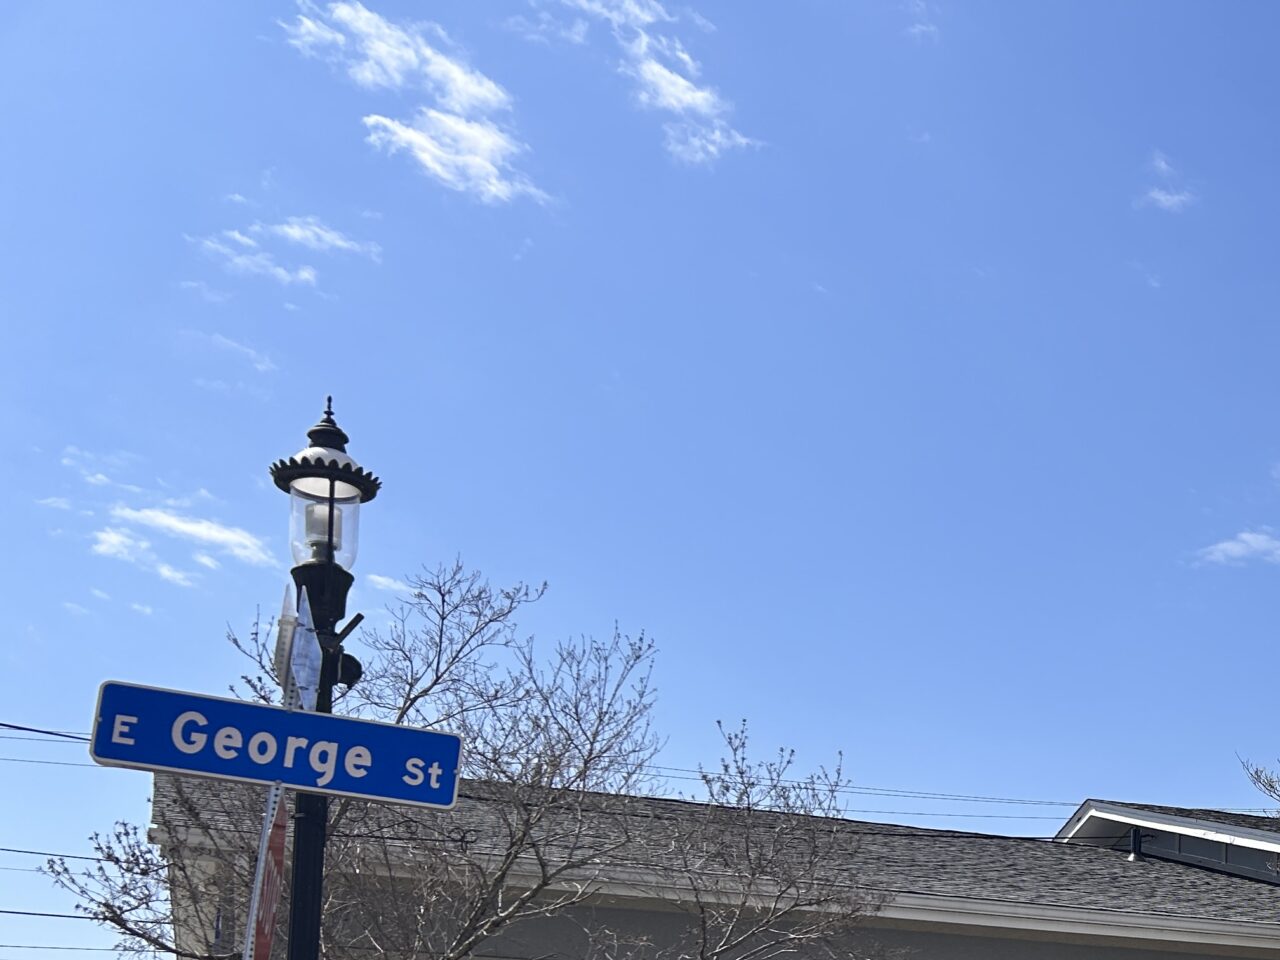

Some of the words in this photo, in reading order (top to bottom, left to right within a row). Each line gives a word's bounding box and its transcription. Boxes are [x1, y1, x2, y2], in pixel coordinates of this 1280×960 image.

[111, 714, 139, 746] E
[171, 711, 372, 787] George
[402, 757, 443, 790] St
